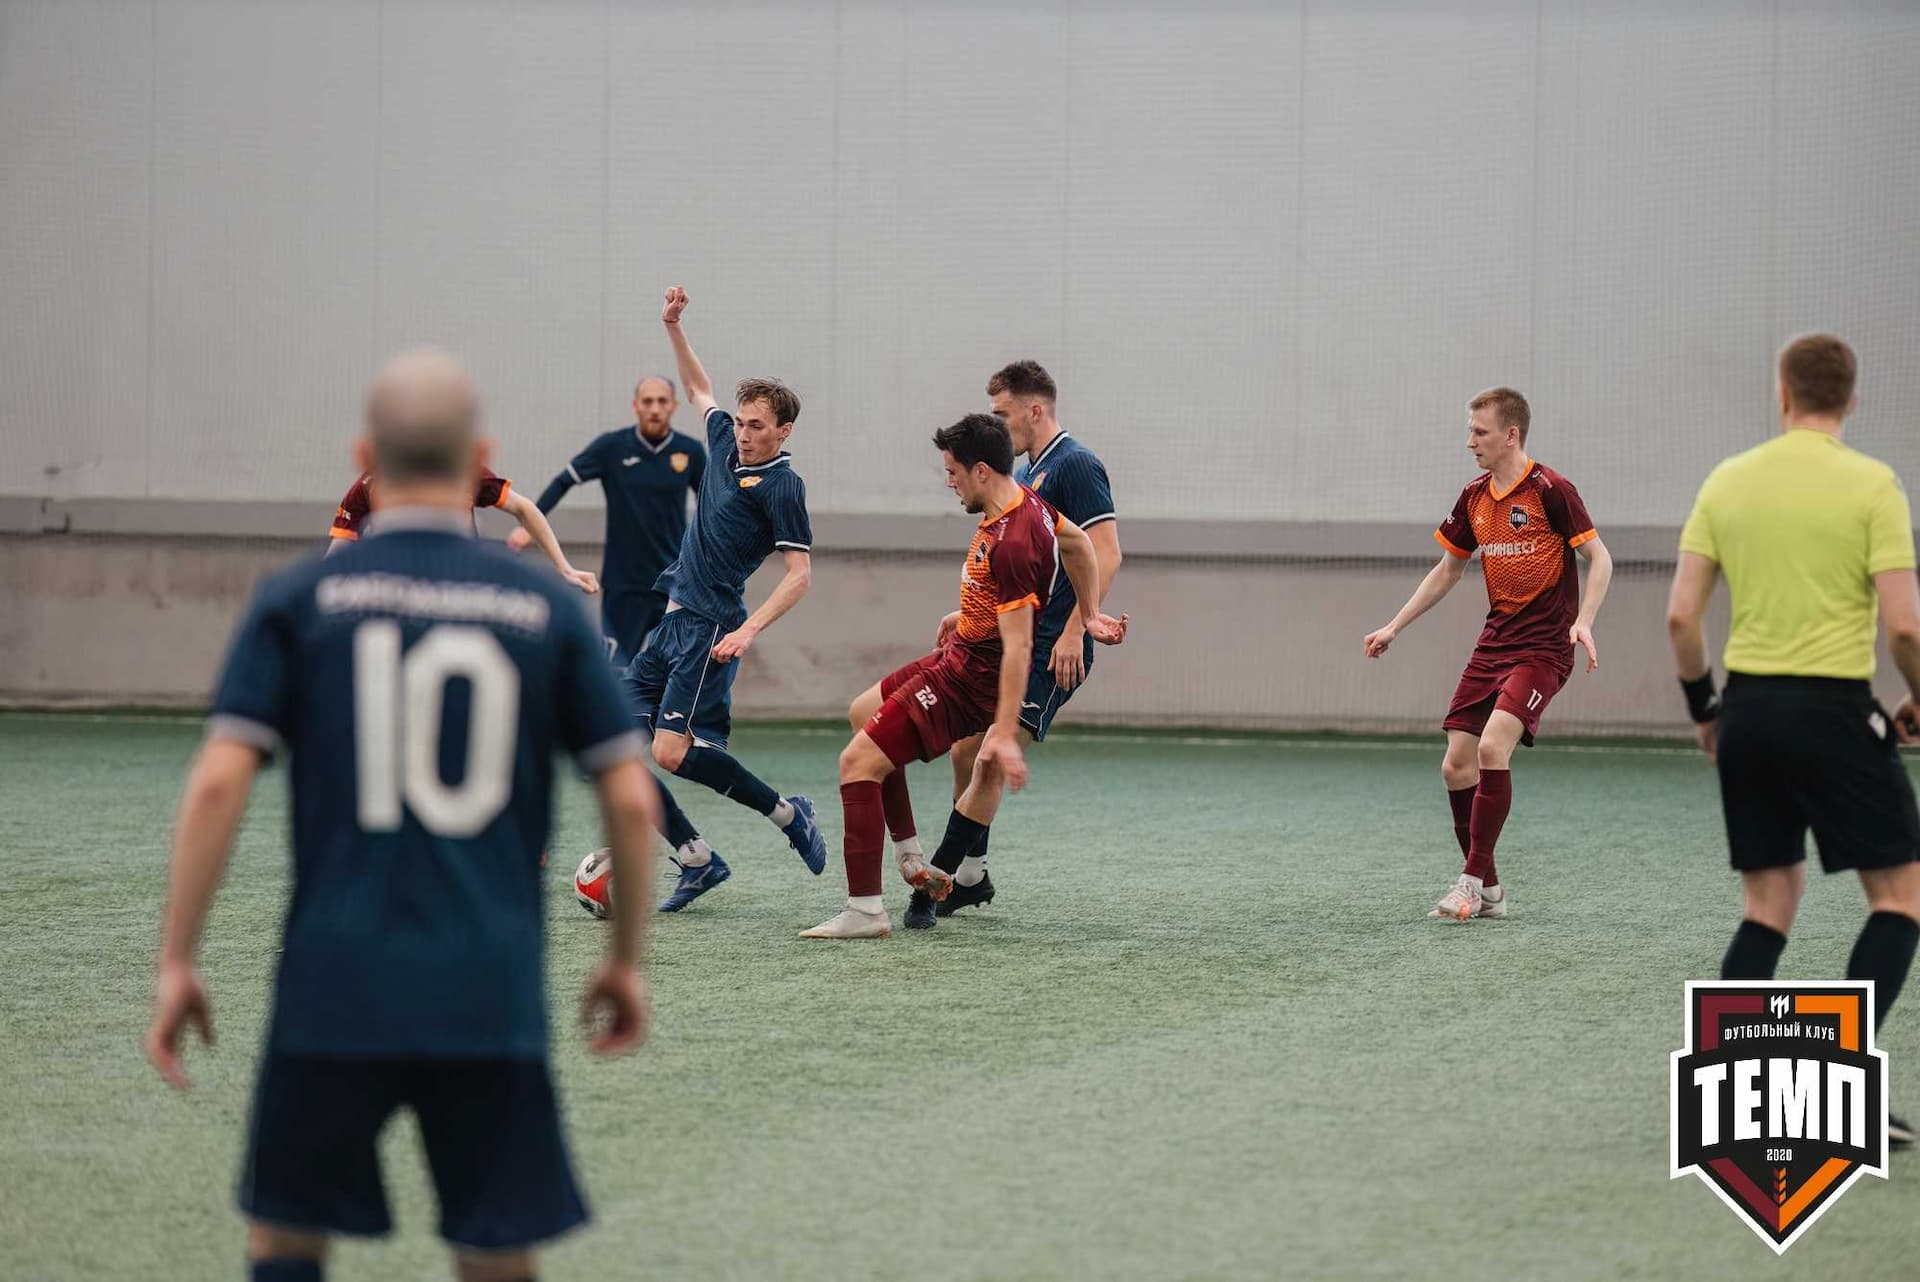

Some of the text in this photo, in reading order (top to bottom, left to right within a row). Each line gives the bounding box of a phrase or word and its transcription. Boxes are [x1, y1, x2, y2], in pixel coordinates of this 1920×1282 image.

[914, 684, 938, 711] 22
[1526, 688, 1543, 710] 17
[353, 618, 522, 840] 10
